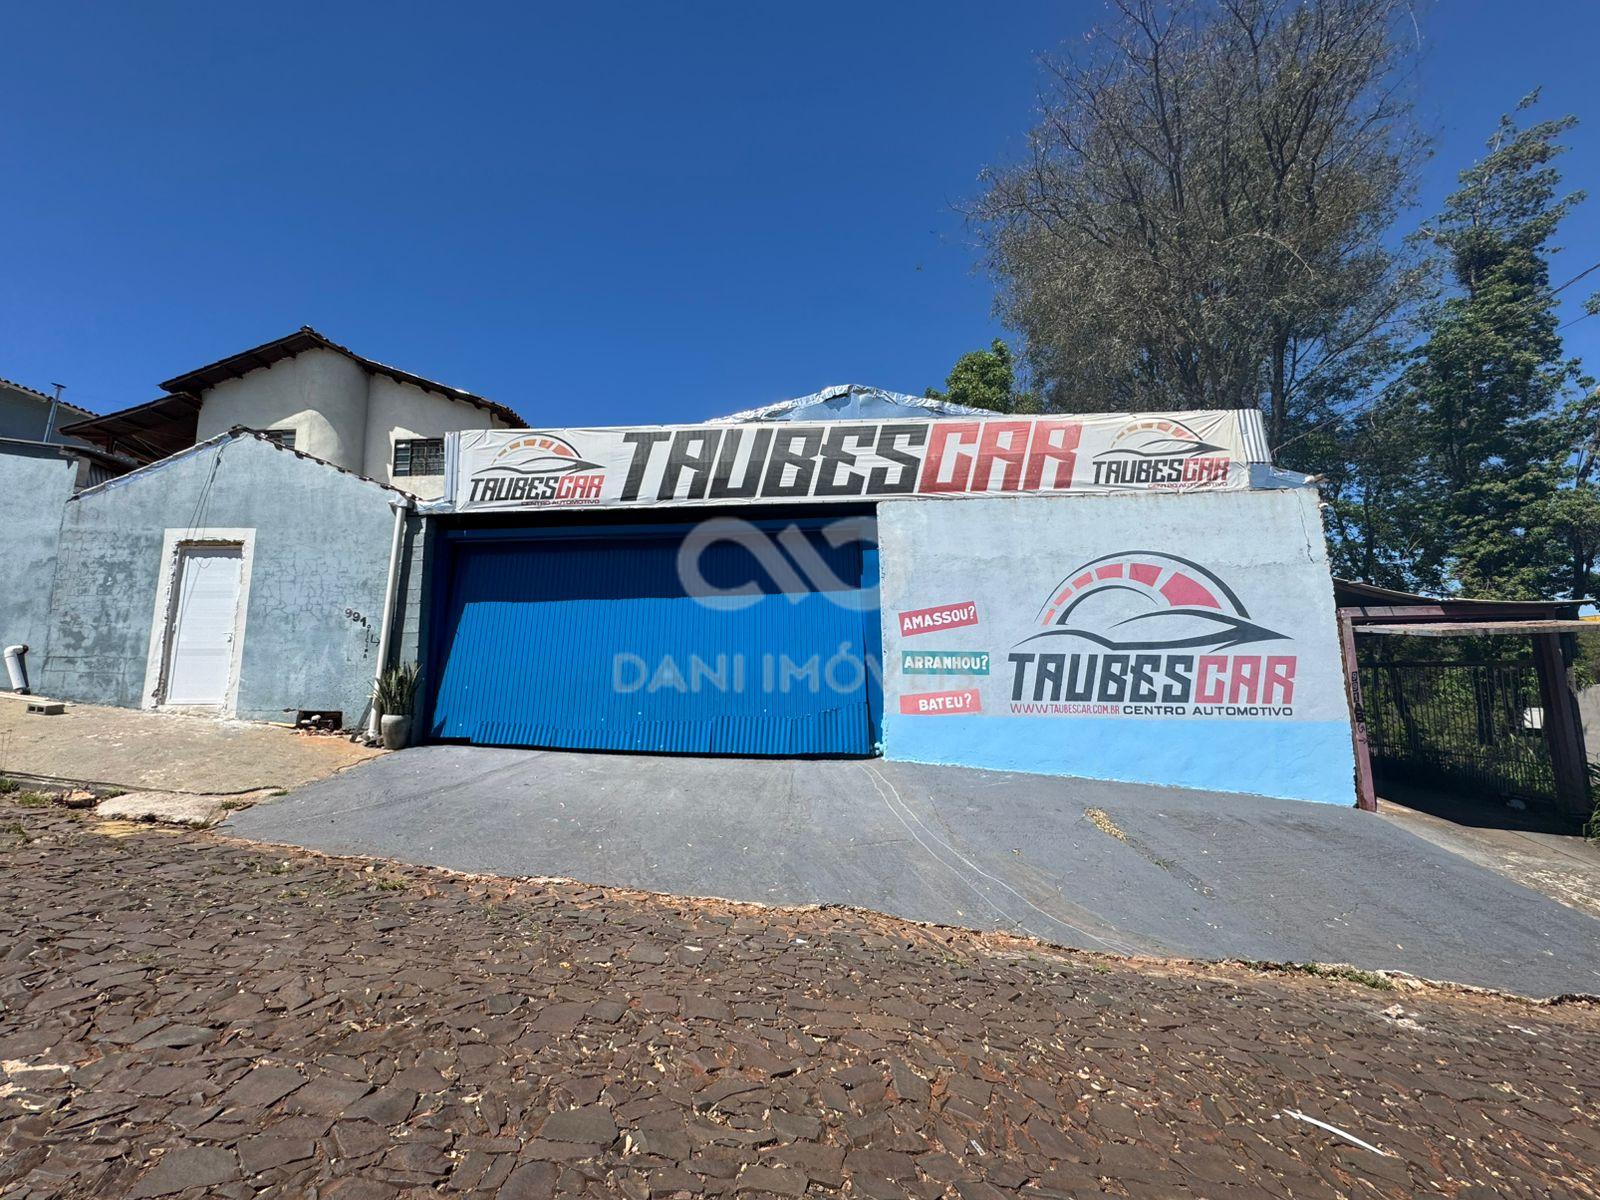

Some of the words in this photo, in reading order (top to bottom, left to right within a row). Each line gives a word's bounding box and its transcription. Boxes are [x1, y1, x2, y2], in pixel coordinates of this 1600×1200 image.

[620, 422, 1083, 501] TAUBESCAR
[1092, 457, 1230, 485] TAUBESCAR
[469, 474, 605, 501] TAUBESCAR
[345, 608, 366, 627] 991
[902, 604, 976, 632] AMASSOU?
[903, 654, 989, 671] ARRANHOU?
[1008, 653, 1297, 705] TAUBESCAR
[918, 692, 972, 712] BATEU?
[1123, 705, 1187, 716] CENTRO
[1192, 705, 1294, 717] AUTOMOTIVO
